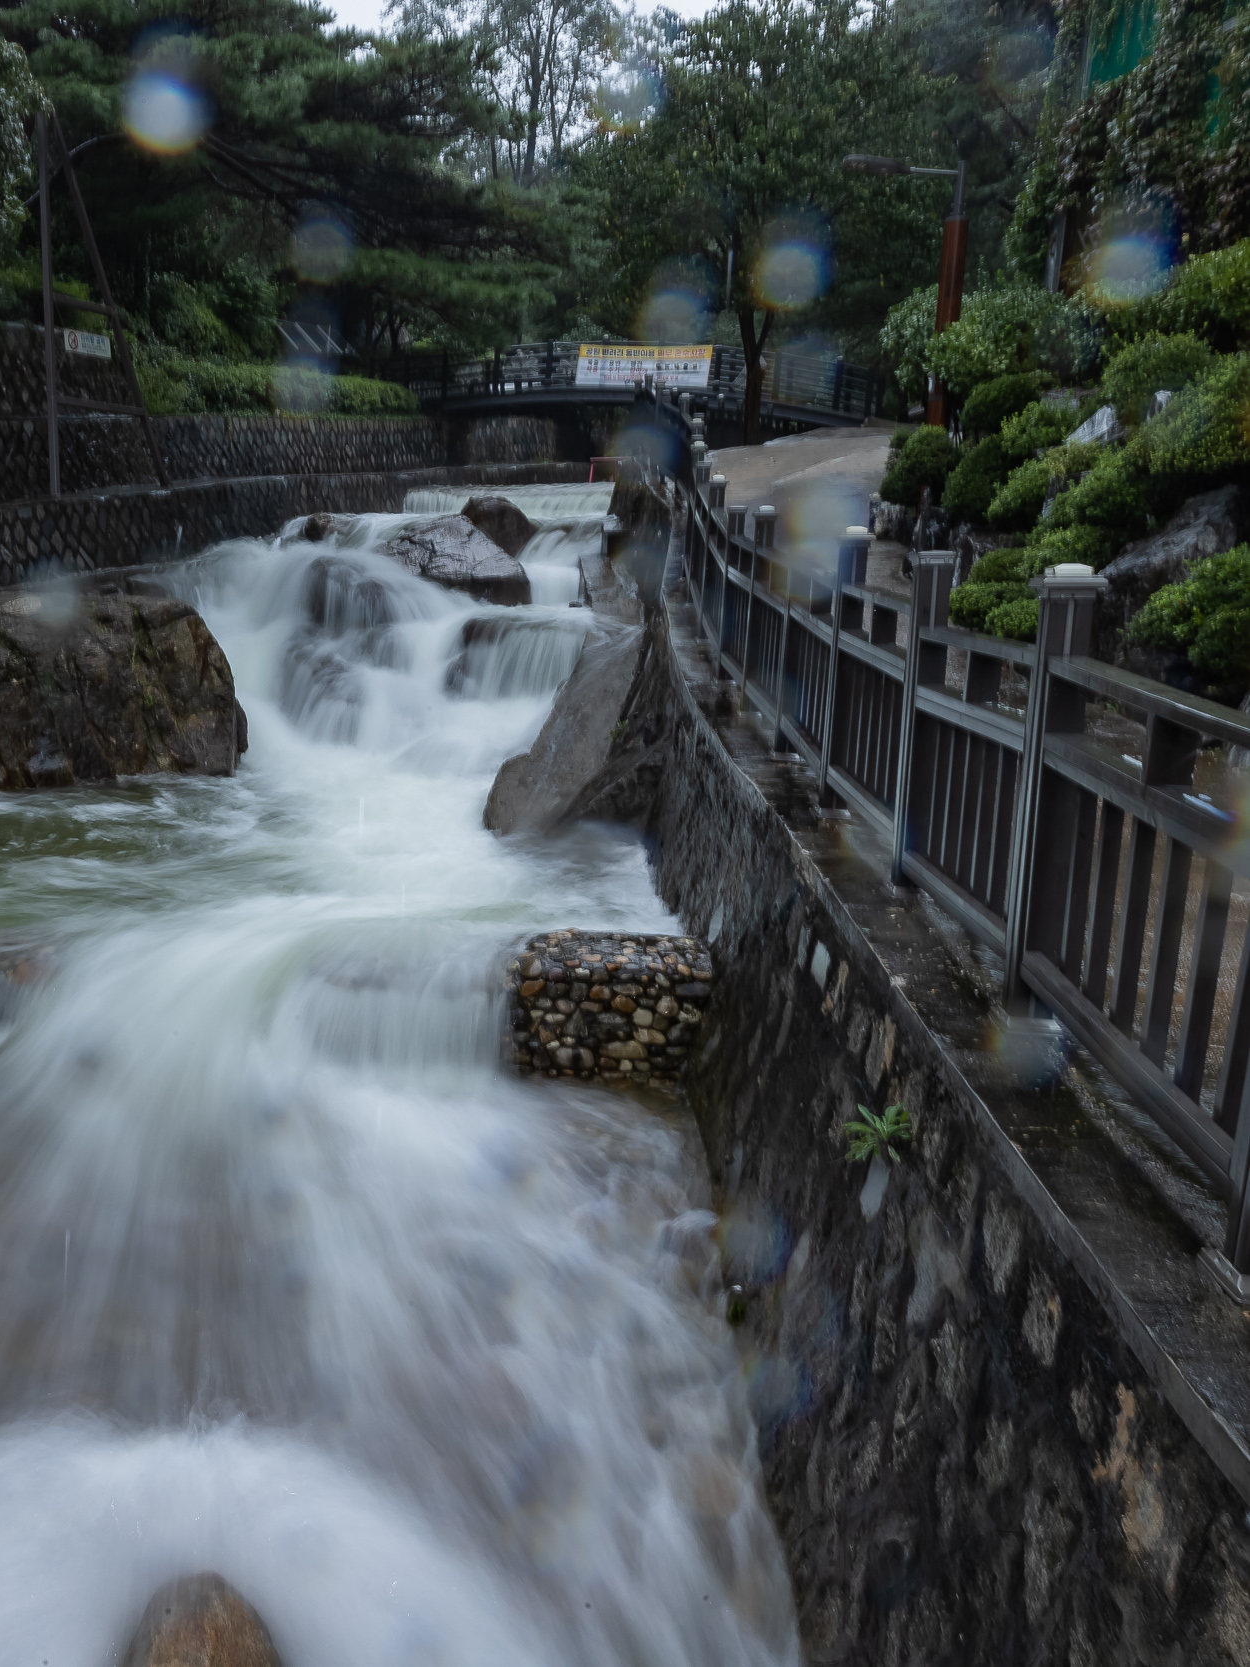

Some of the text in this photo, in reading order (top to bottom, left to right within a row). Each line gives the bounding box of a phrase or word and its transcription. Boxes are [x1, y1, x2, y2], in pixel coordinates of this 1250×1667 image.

[586, 347, 600, 356] 공원
[602, 348, 624, 357] 반려견
[626, 348, 655, 357] 동반이용
[675, 348, 706, 357] 준수사항
